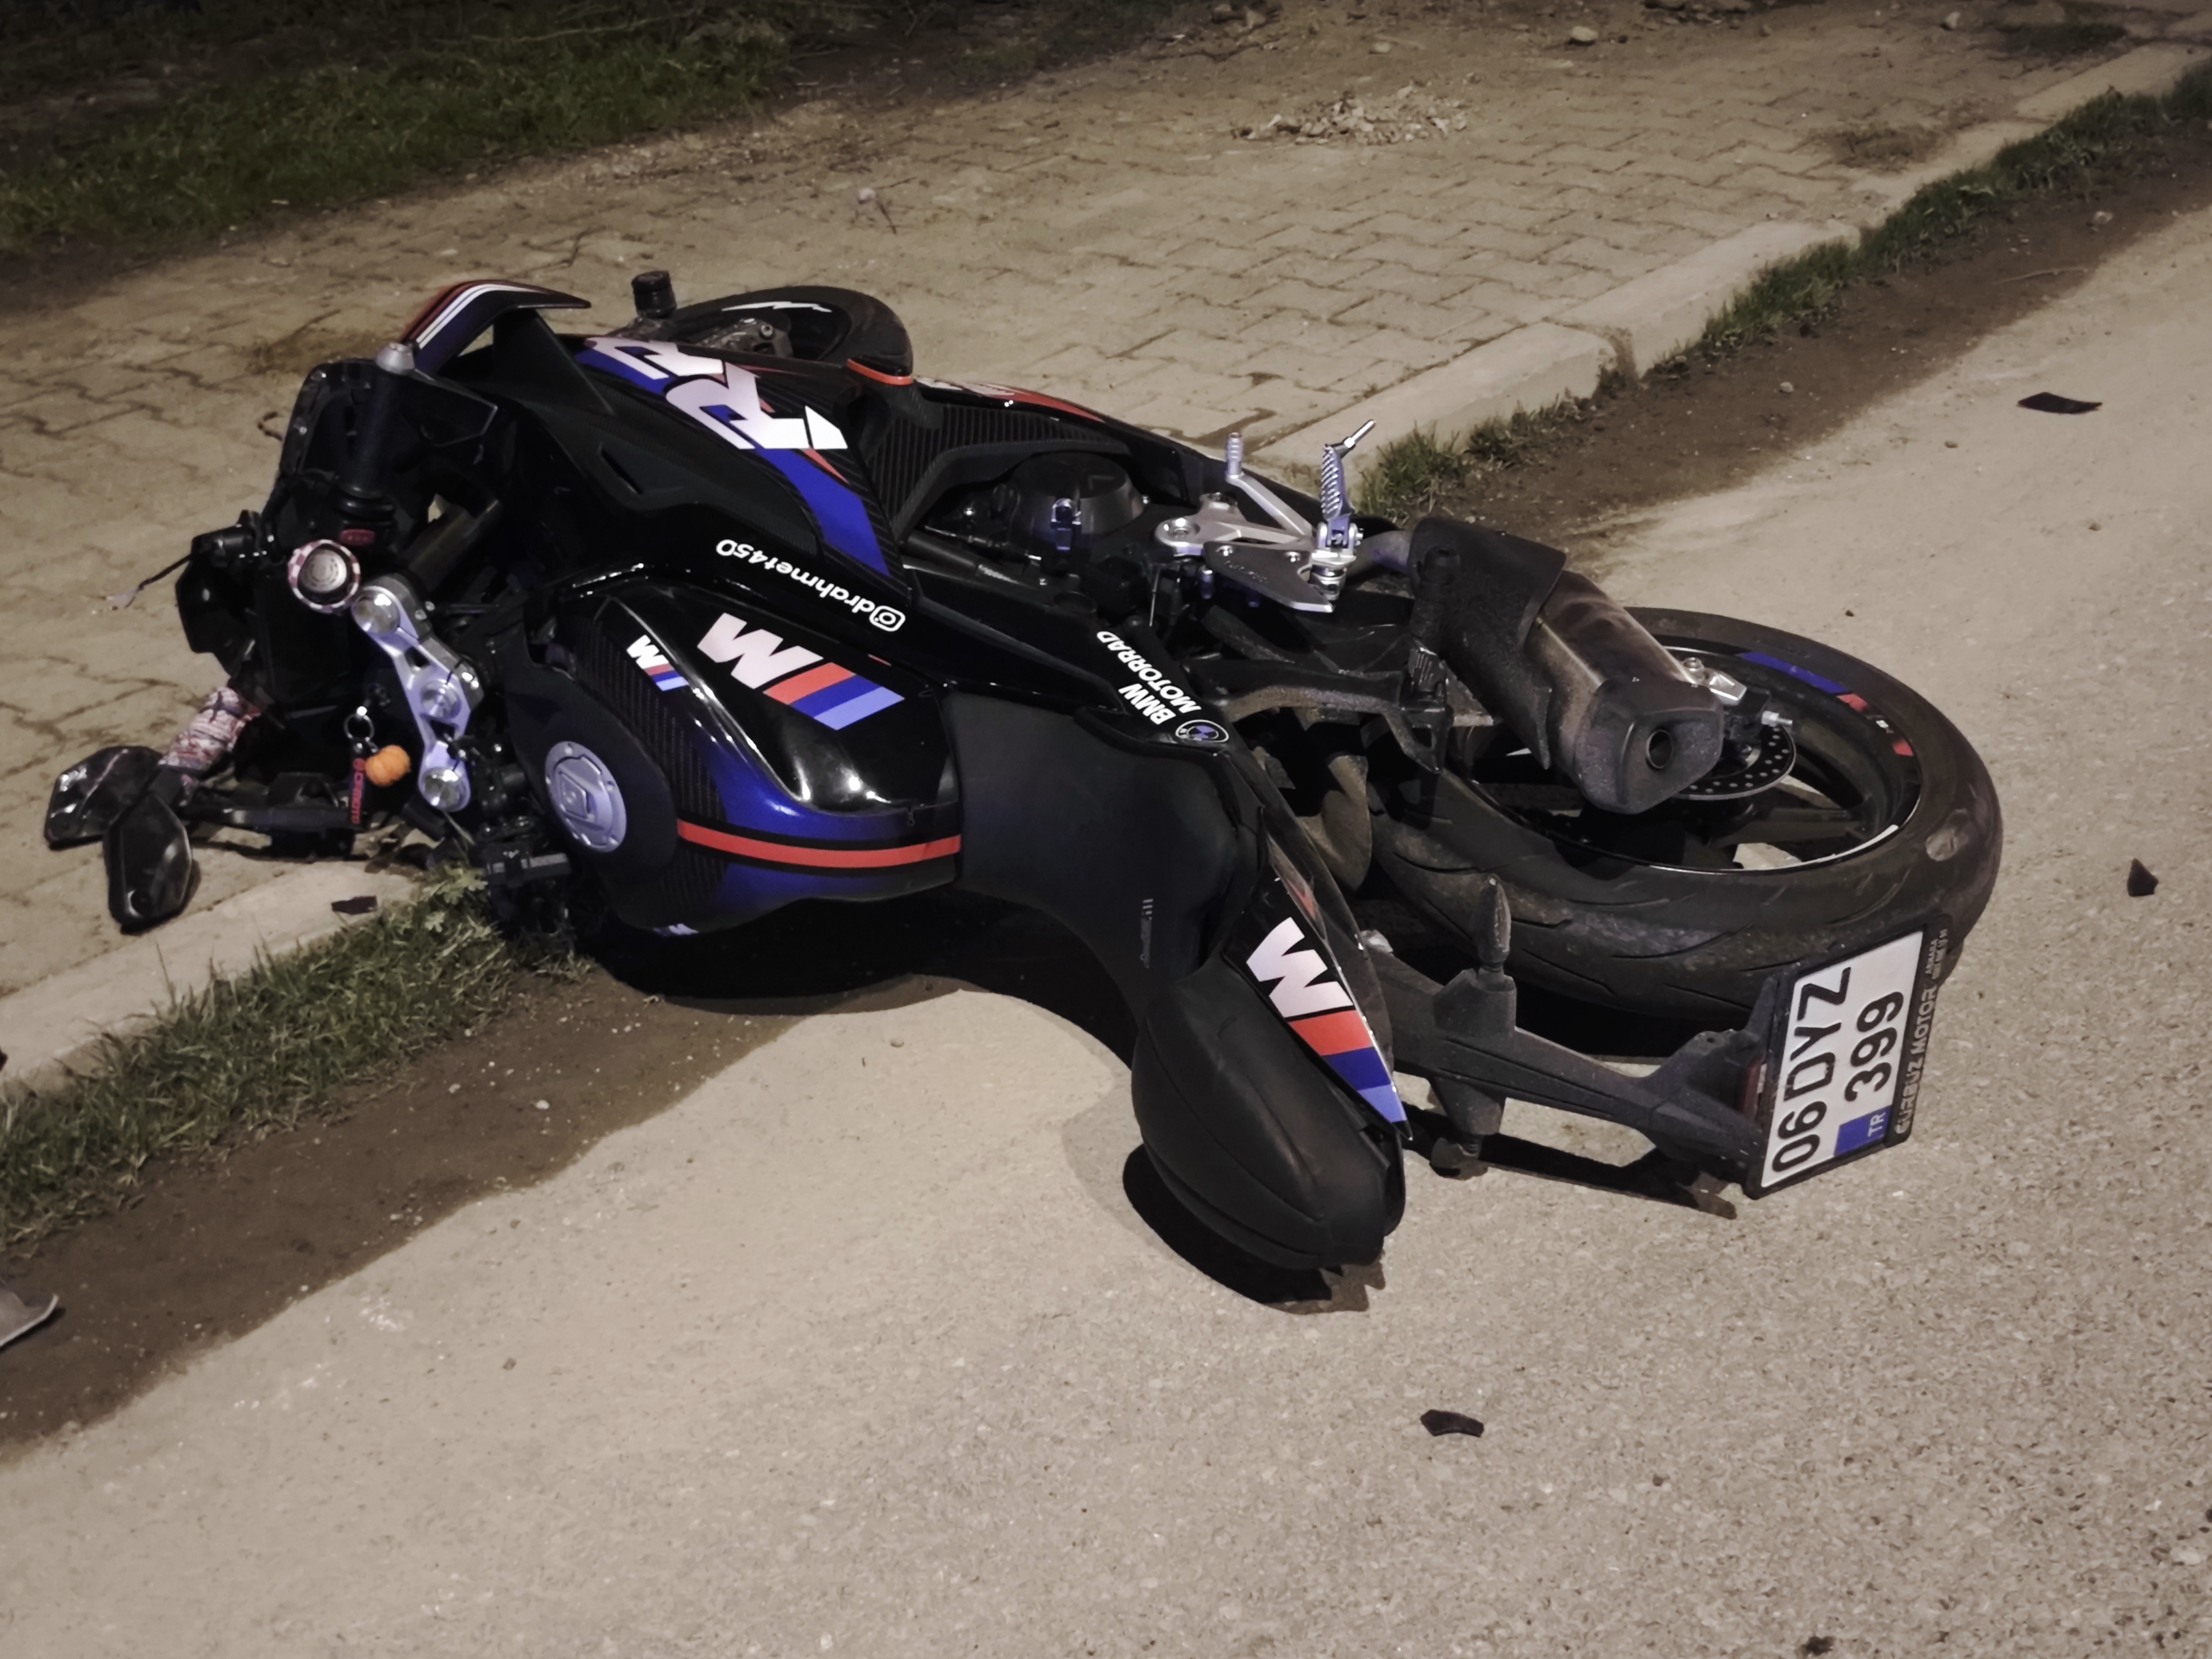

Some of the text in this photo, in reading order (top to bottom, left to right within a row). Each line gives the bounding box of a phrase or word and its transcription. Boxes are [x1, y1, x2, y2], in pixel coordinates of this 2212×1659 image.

[1096, 631, 1202, 713] MOTORRAD
[1118, 683, 1176, 725] BMW
[1844, 992, 1904, 1102] 399
[1910, 984, 1938, 1054] MOTOR
[1772, 967, 1851, 1172] 06DYZ
[1867, 1111, 1886, 1137] TR
